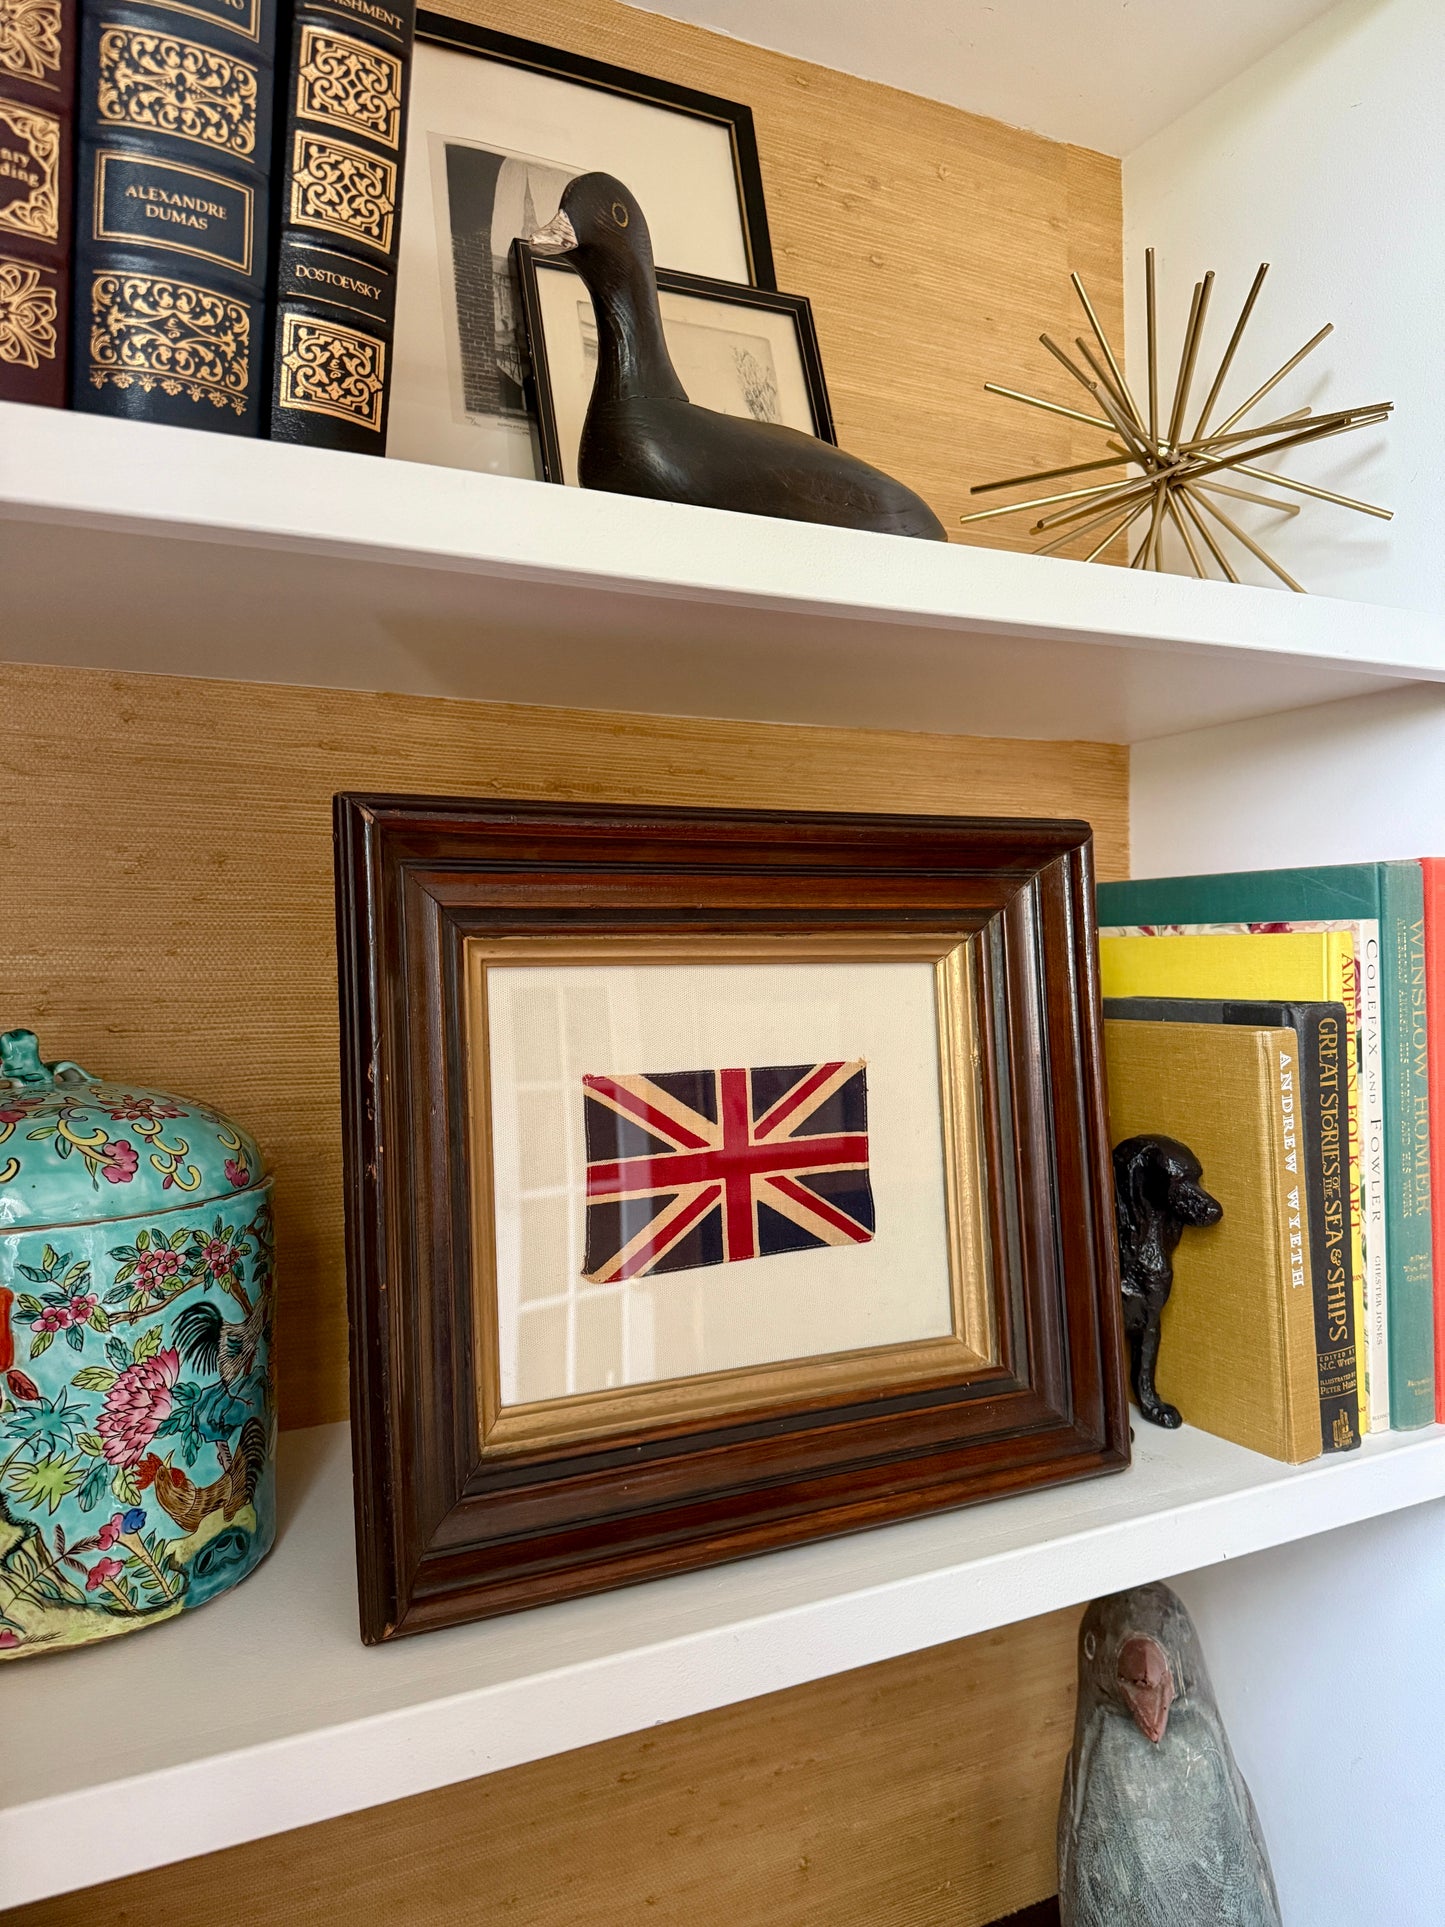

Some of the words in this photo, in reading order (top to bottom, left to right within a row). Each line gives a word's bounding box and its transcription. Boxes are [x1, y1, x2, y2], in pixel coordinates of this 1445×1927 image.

[125, 184, 227, 220] ALEXANDRE
[146, 203, 208, 231] DUMAS
[295, 264, 382, 300] DOSTOEVSKY
[1366, 939, 1378, 1056] COLEFAX
[1409, 917, 1428, 1078] WINSLOW
[1318, 1017, 1339, 1091] GREAT
[1400, 1042, 1410, 1064] HIS
[1341, 953, 1358, 1092] AMERICAN
[1350, 1182, 1361, 1235] ART
[1368, 1070, 1377, 1104] AND
[1280, 1051, 1298, 1174] ANDREW
[1320, 1093, 1341, 1176] STORIES
[1401, 1120, 1411, 1146] AND
[1370, 1119, 1382, 1222] FOWLER
[1402, 1152, 1412, 1173] HIS
[1413, 1095, 1431, 1216] HOMER
[1325, 1176, 1333, 1198] THE
[1332, 1176, 1340, 1190] OF
[1403, 1180, 1413, 1218] WORK
[1287, 1186, 1305, 1288] WYETH
[1324, 1200, 1343, 1248] SEA
[1330, 1248, 1342, 1266] &
[1374, 1255, 1382, 1308] CHESTER
[1327, 1268, 1348, 1342] SHIPS
[1376, 1310, 1384, 1346] JONES
[1320, 1351, 1346, 1362] EDITED
[1320, 1361, 1336, 1371] N.C.
[1320, 1385, 1341, 1395] PETER
